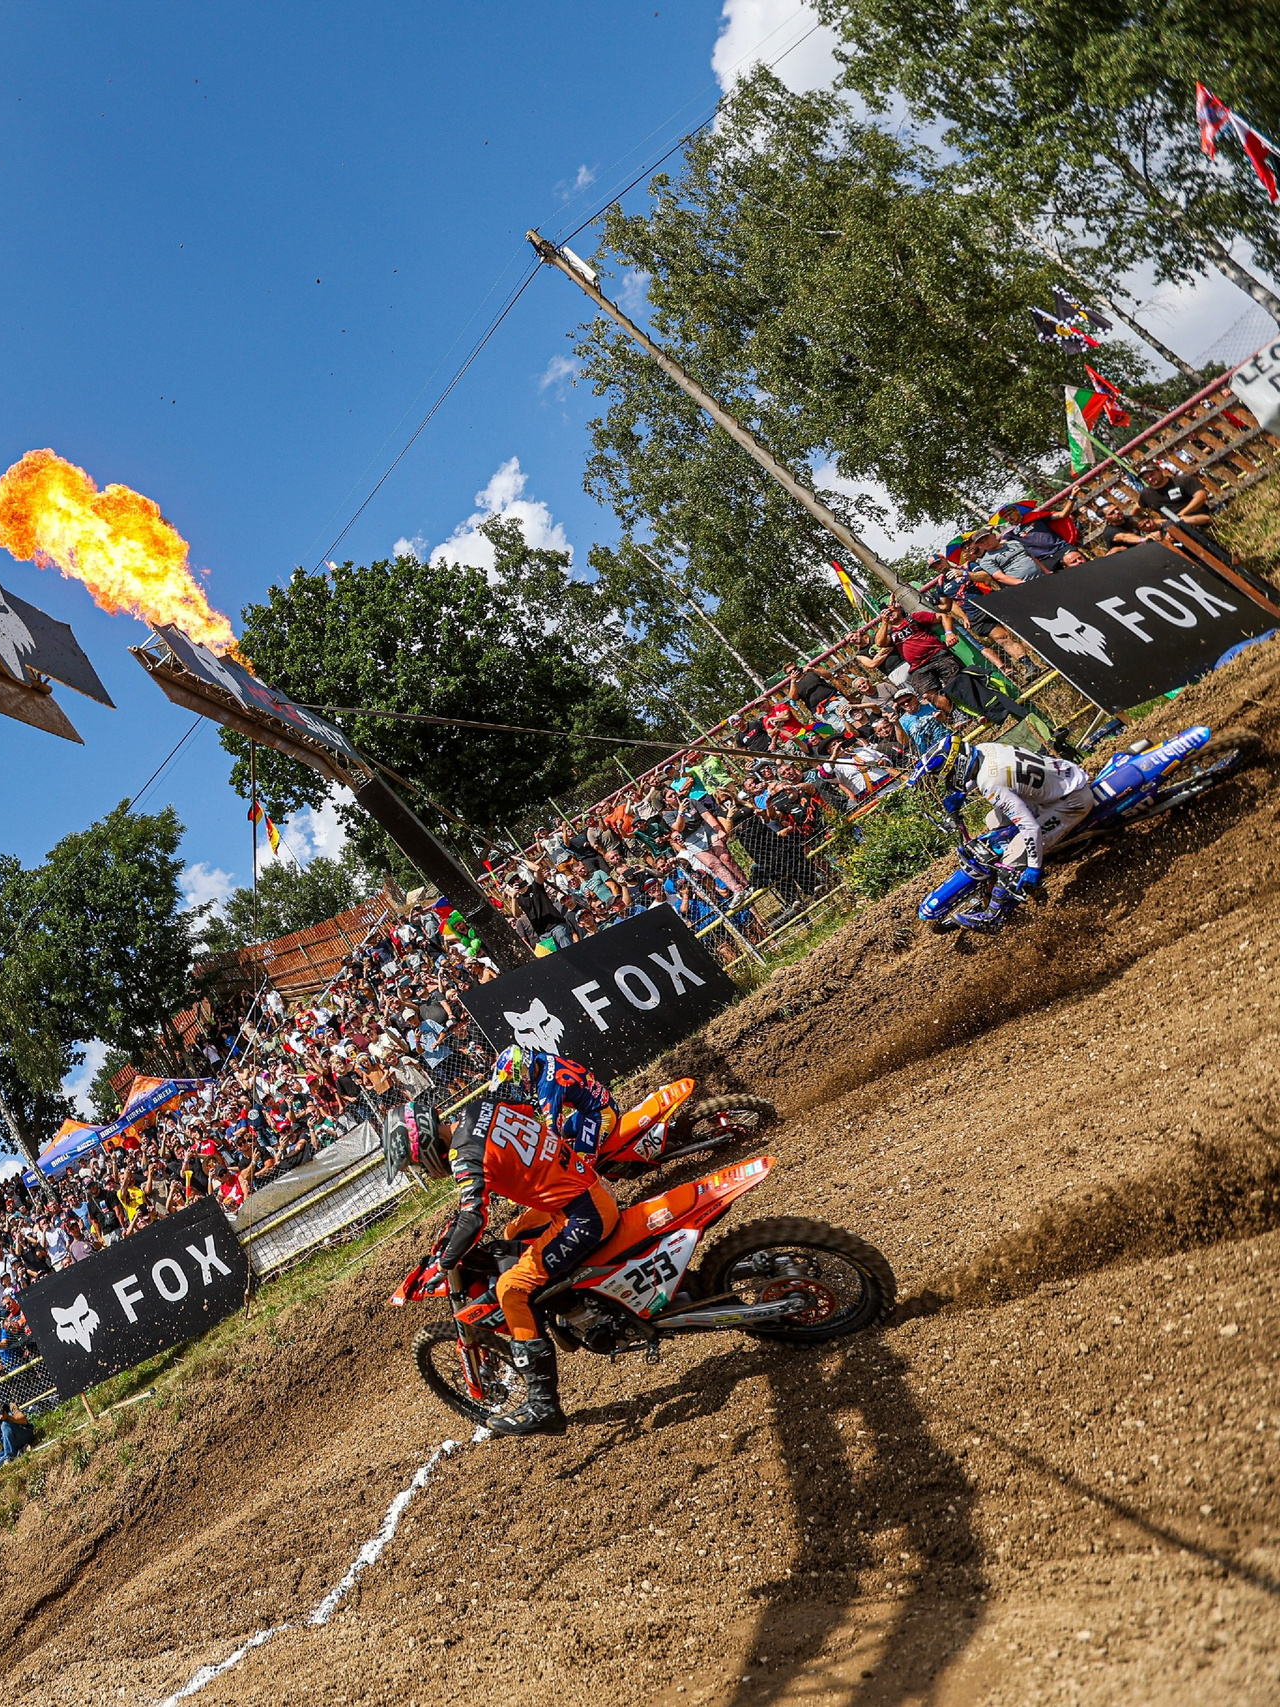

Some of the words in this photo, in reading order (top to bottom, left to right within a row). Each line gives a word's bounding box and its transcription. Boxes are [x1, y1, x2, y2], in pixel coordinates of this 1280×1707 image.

[1095, 573, 1238, 643] FOX
[891, 626, 912, 643] FOX
[571, 943, 706, 1032] FOX
[555, 1056, 587, 1087] 96
[152, 1088, 173, 1104] BIRELL
[126, 1106, 146, 1122] BIRELL
[100, 1124, 120, 1139] BIRELL
[491, 1105, 542, 1168] 253
[642, 1131, 662, 1150] 96
[51, 1153, 70, 1168] BIRELL
[112, 1234, 232, 1324] FOX
[624, 1251, 679, 1295] 253
